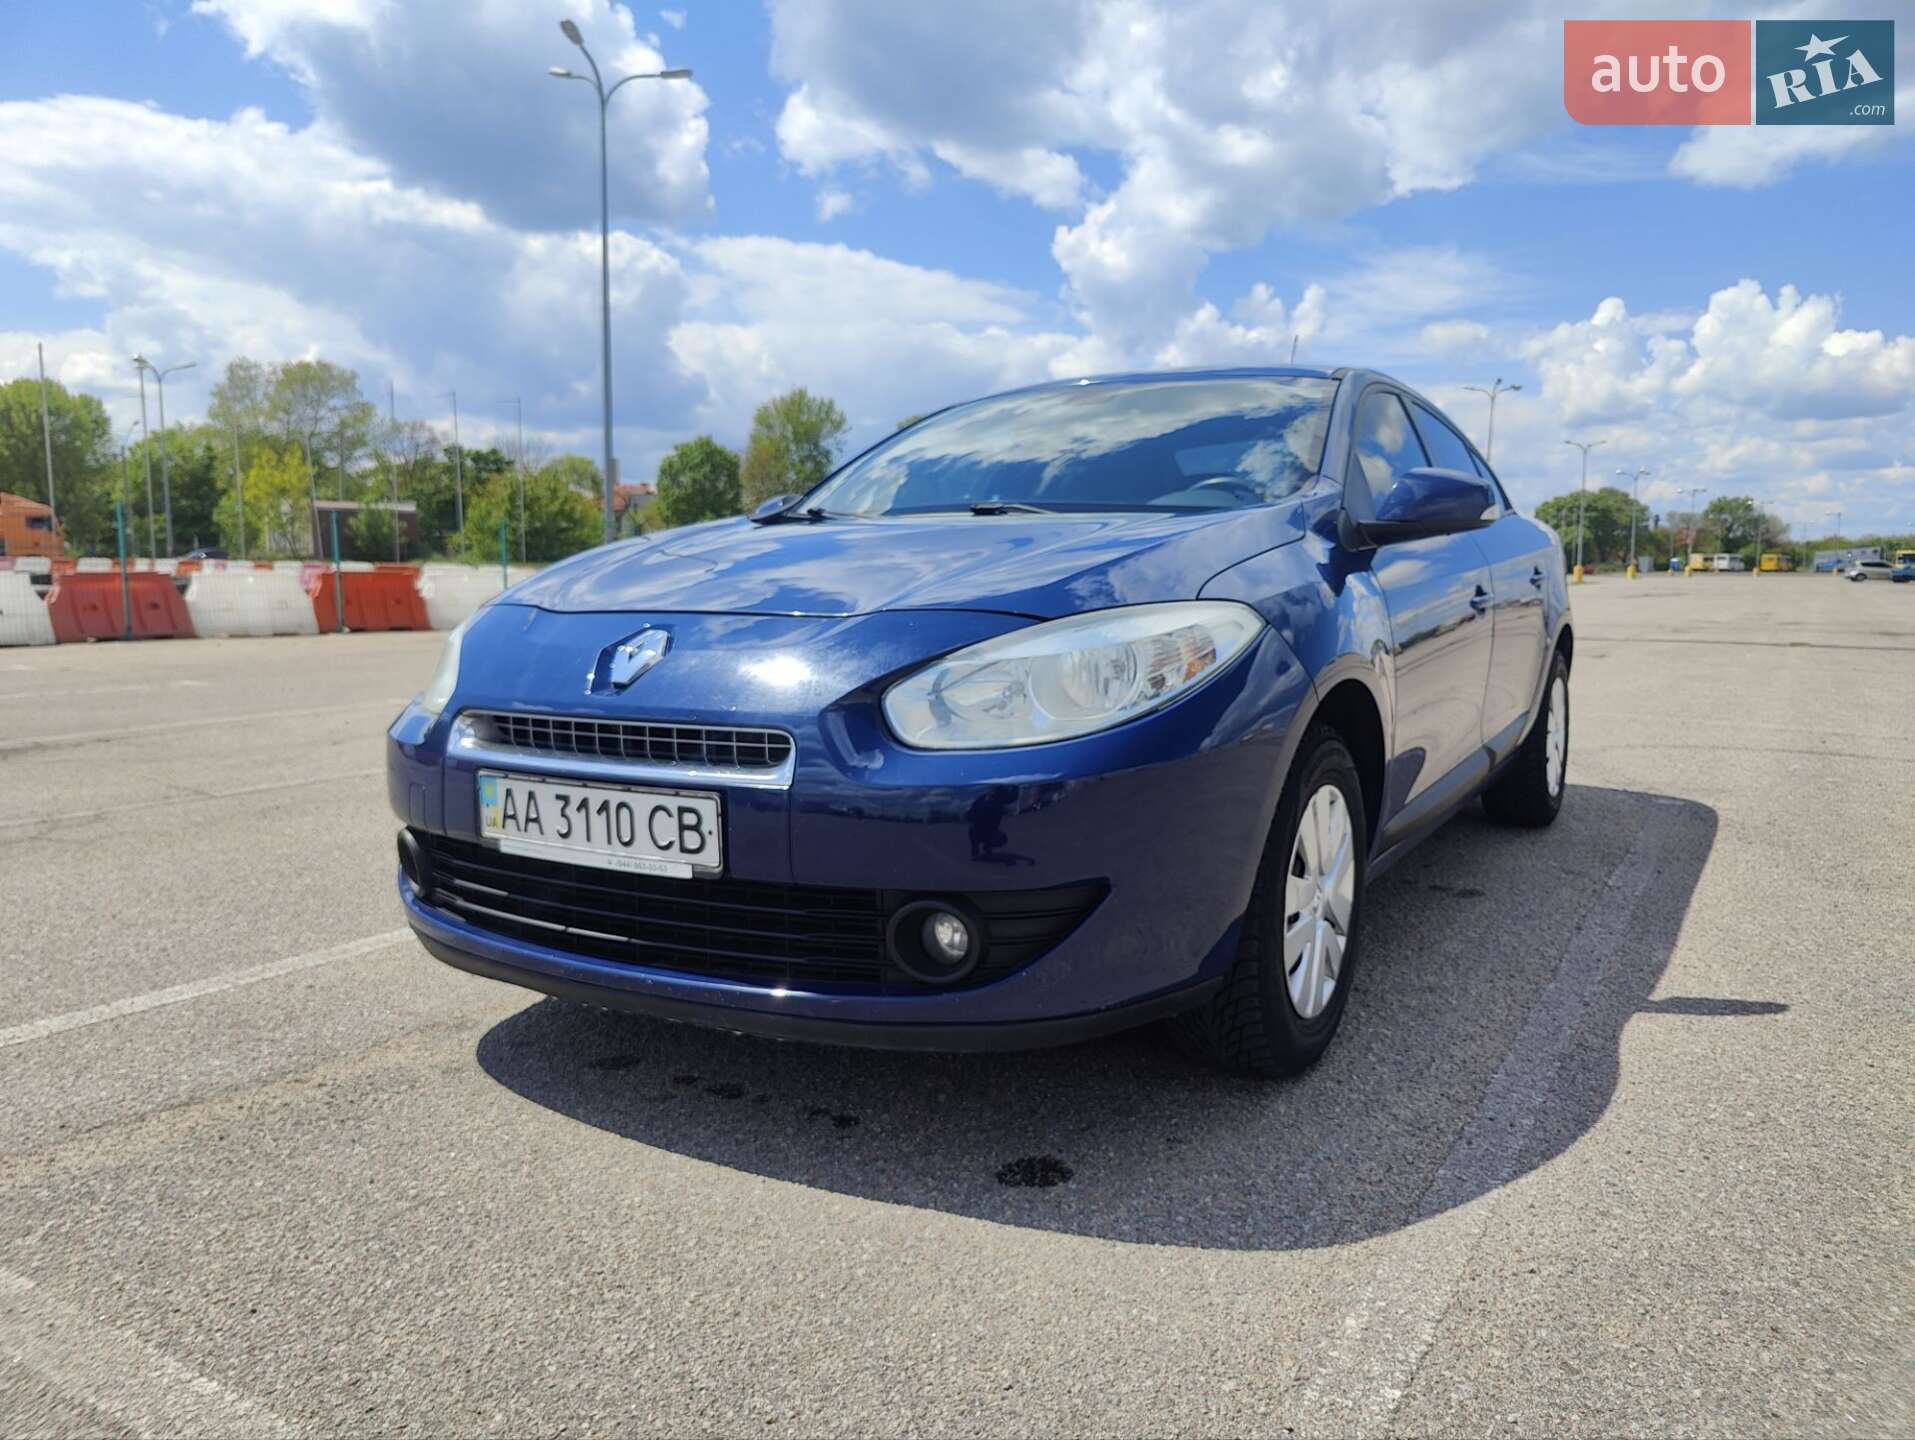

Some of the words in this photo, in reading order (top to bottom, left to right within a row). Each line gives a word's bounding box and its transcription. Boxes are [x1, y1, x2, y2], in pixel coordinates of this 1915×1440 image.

[485, 815, 498, 828] UA
[502, 787, 544, 836] AA
[555, 793, 635, 848] 3110
[648, 804, 706, 854] CB
